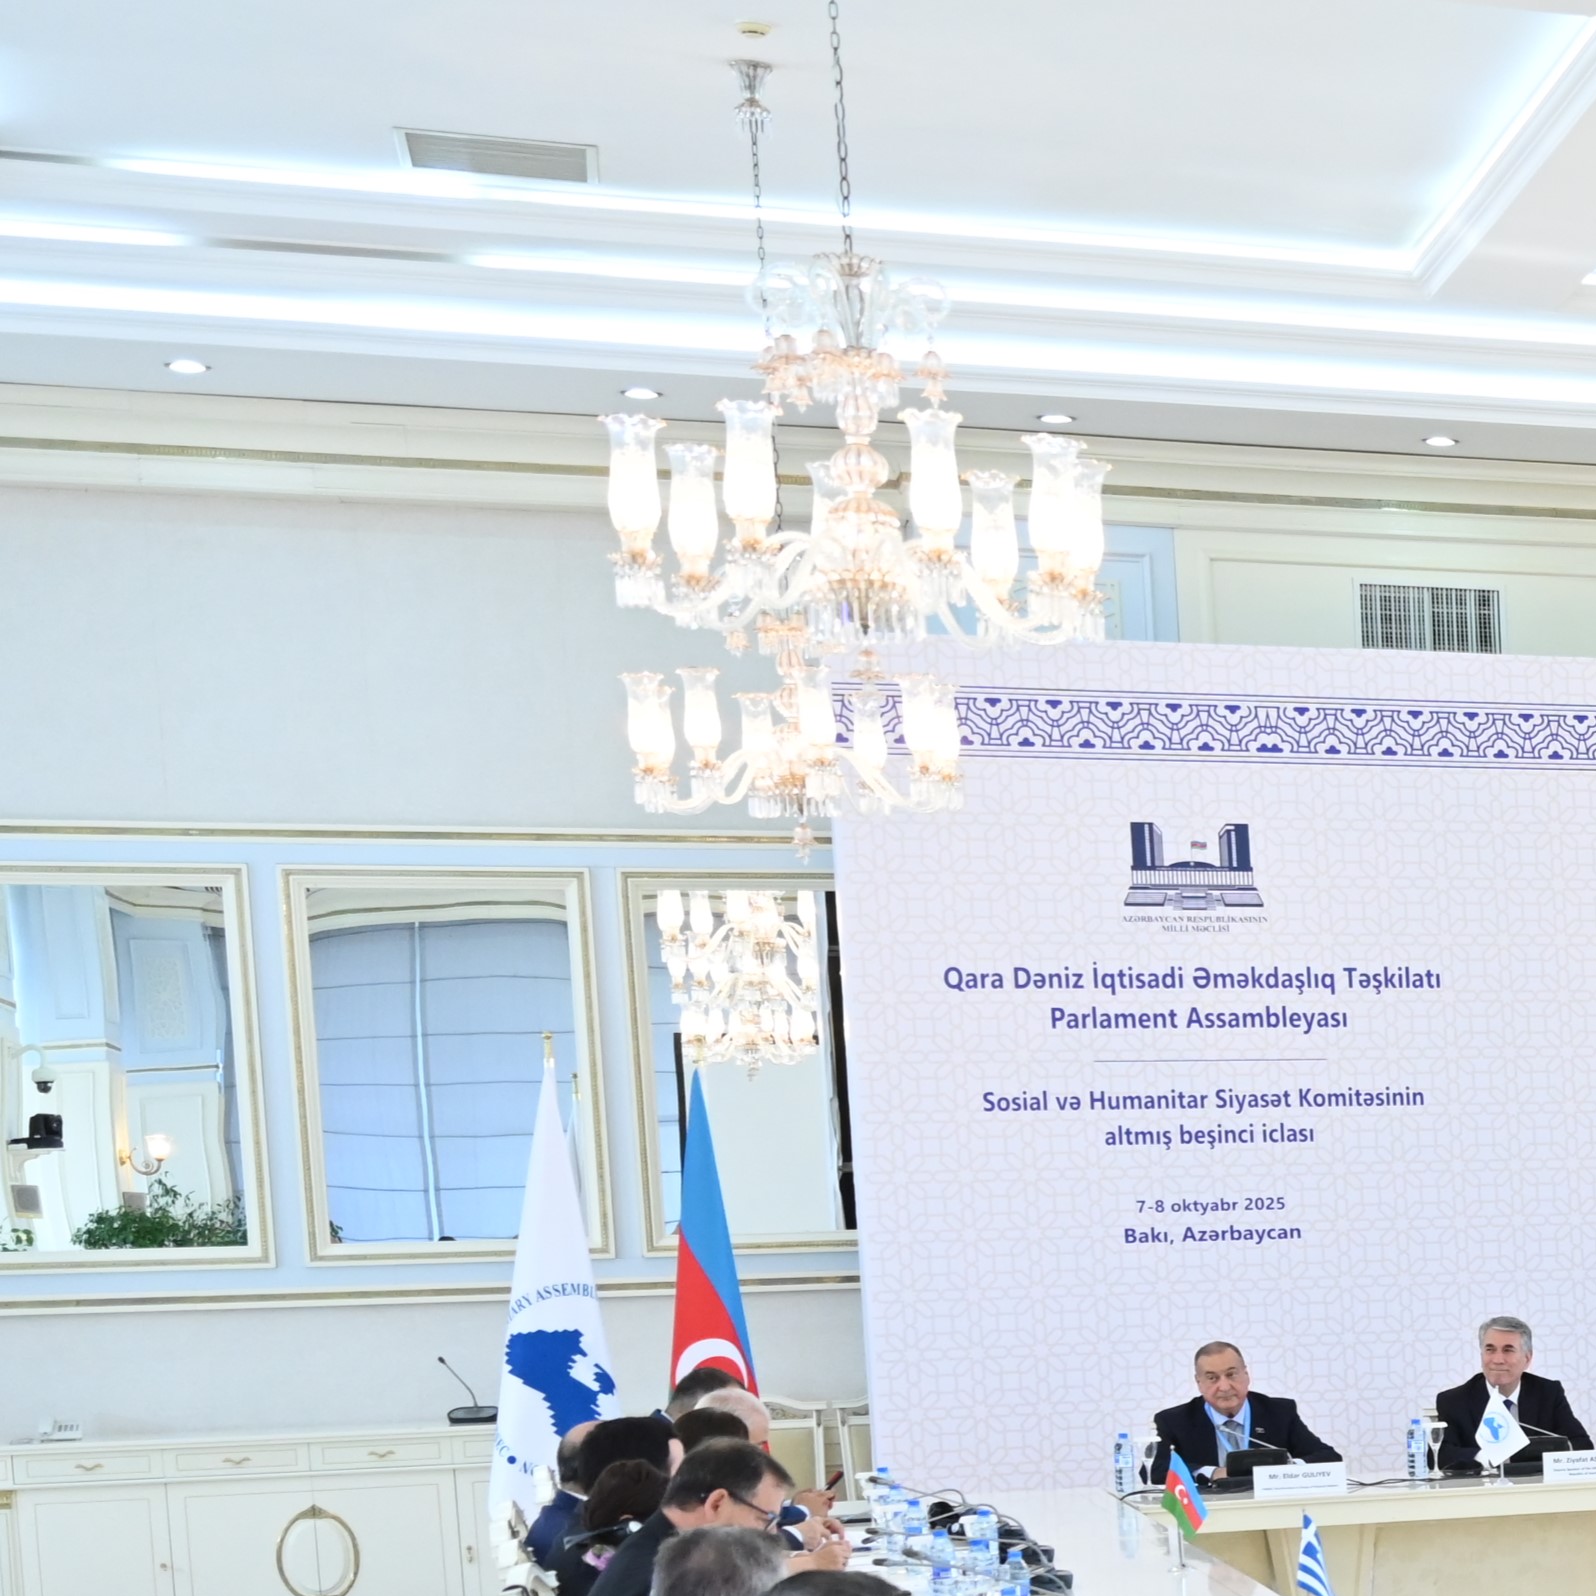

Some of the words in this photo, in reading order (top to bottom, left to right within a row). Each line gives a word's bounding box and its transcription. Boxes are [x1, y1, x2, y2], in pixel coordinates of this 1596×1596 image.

[944, 967, 1003, 991] Qara
[1014, 966, 1084, 989] Dəniz
[1093, 962, 1183, 995] İqtisadi
[1193, 966, 1335, 995] Əməkdaşlıq
[1343, 966, 1440, 994] Təşkilatı
[1051, 1006, 1178, 1029] Parlament
[1187, 1006, 1347, 1034] Assambleyası
[983, 1091, 1047, 1111] Sosial
[1056, 1096, 1081, 1110] və
[1090, 1089, 1208, 1110] Humanitar
[1216, 1089, 1291, 1114] Siyasət
[1299, 1087, 1424, 1107] Komitəsinin
[1105, 1125, 1172, 1150] altmış
[1180, 1124, 1254, 1149] beşinci
[1263, 1123, 1313, 1143] iclası
[1136, 1200, 1164, 1213] 7-8
[1171, 1198, 1238, 1215] oktyabr
[1245, 1197, 1285, 1210] 2025
[1125, 1227, 1173, 1245] Bakı,
[1182, 1225, 1301, 1244] Azərbaycan
[536, 1282, 599, 1303] ASSEMBL
